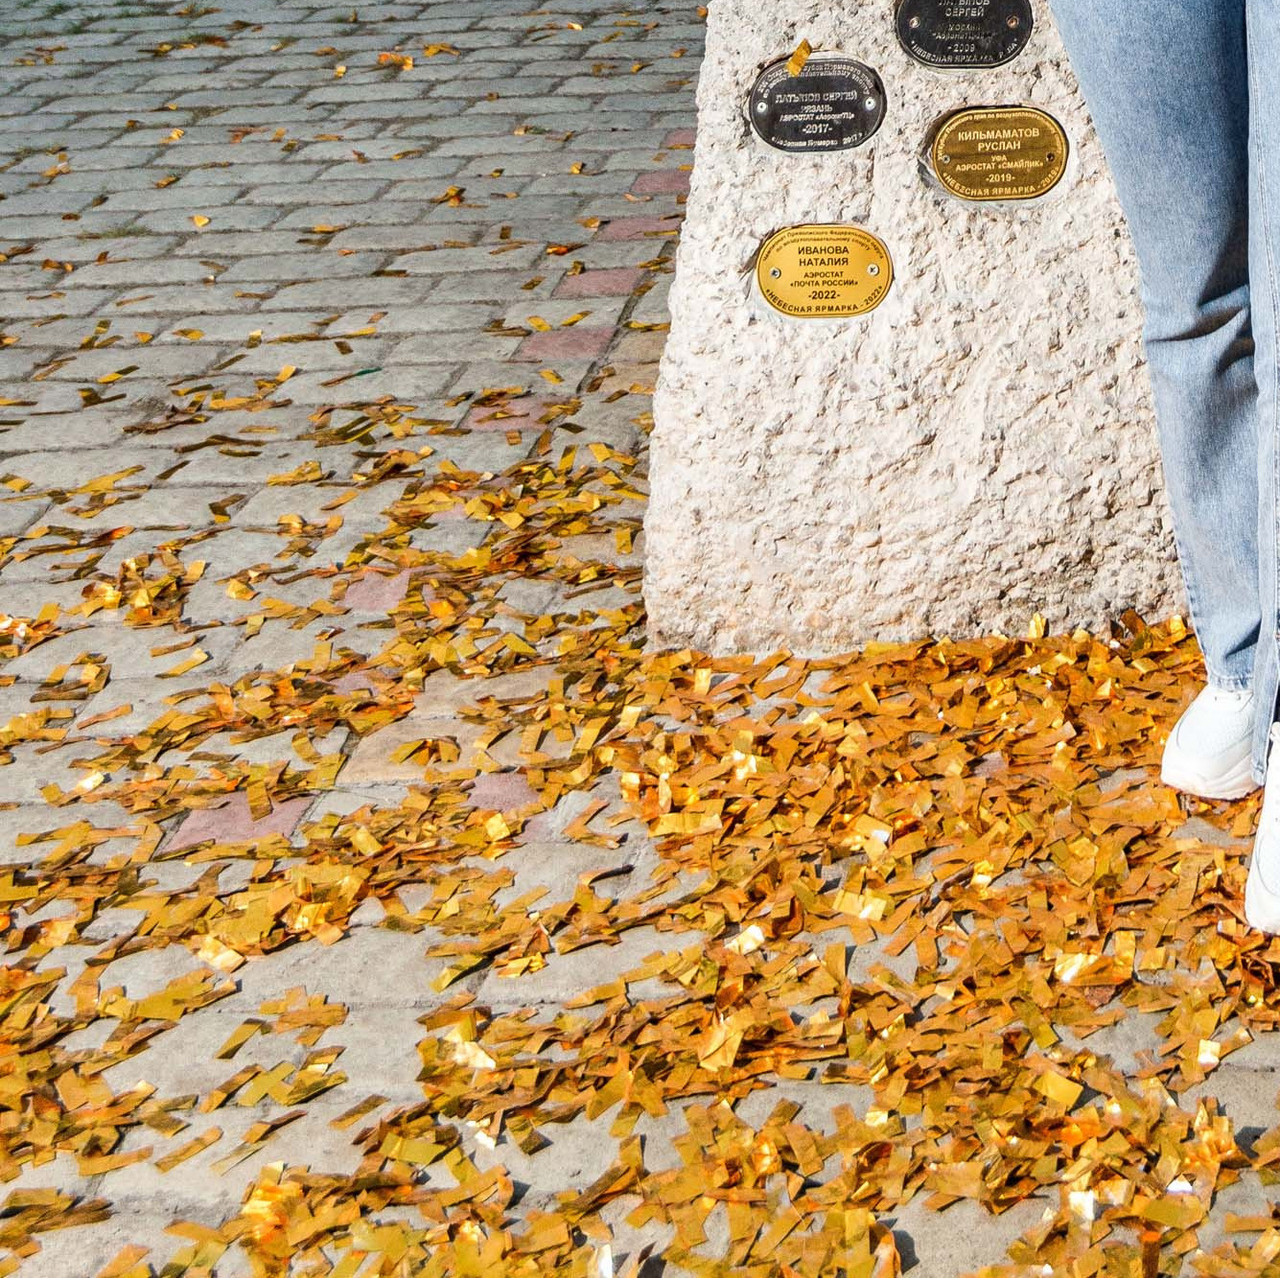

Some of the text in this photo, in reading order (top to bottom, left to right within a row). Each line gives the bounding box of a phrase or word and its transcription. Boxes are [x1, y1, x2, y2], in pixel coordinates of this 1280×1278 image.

[945, 6, 985, 17] СЕРГЕЙ
[802, 123, 834, 134] -2017-
[958, 127, 1040, 142] КИЛЬМАМАТОВ
[978, 140, 1021, 153] РУСЛАН
[955, 158, 1044, 172] АЭРОСТАТ «СМАЙЛИК»
[985, 173, 1016, 183] -2019-
[992, 185, 1036, 196] ЯРМАРКА
[798, 245, 850, 256] ИВАНОВА
[798, 257, 850, 267] НАТАЛИЯ
[803, 271, 844, 279] АЭРОСТАТ
[790, 279, 858, 288] «ПОЧТА РОССИИ»
[808, 289, 841, 300] -2022-
[815, 303, 859, 313] ЯРМАРКА
